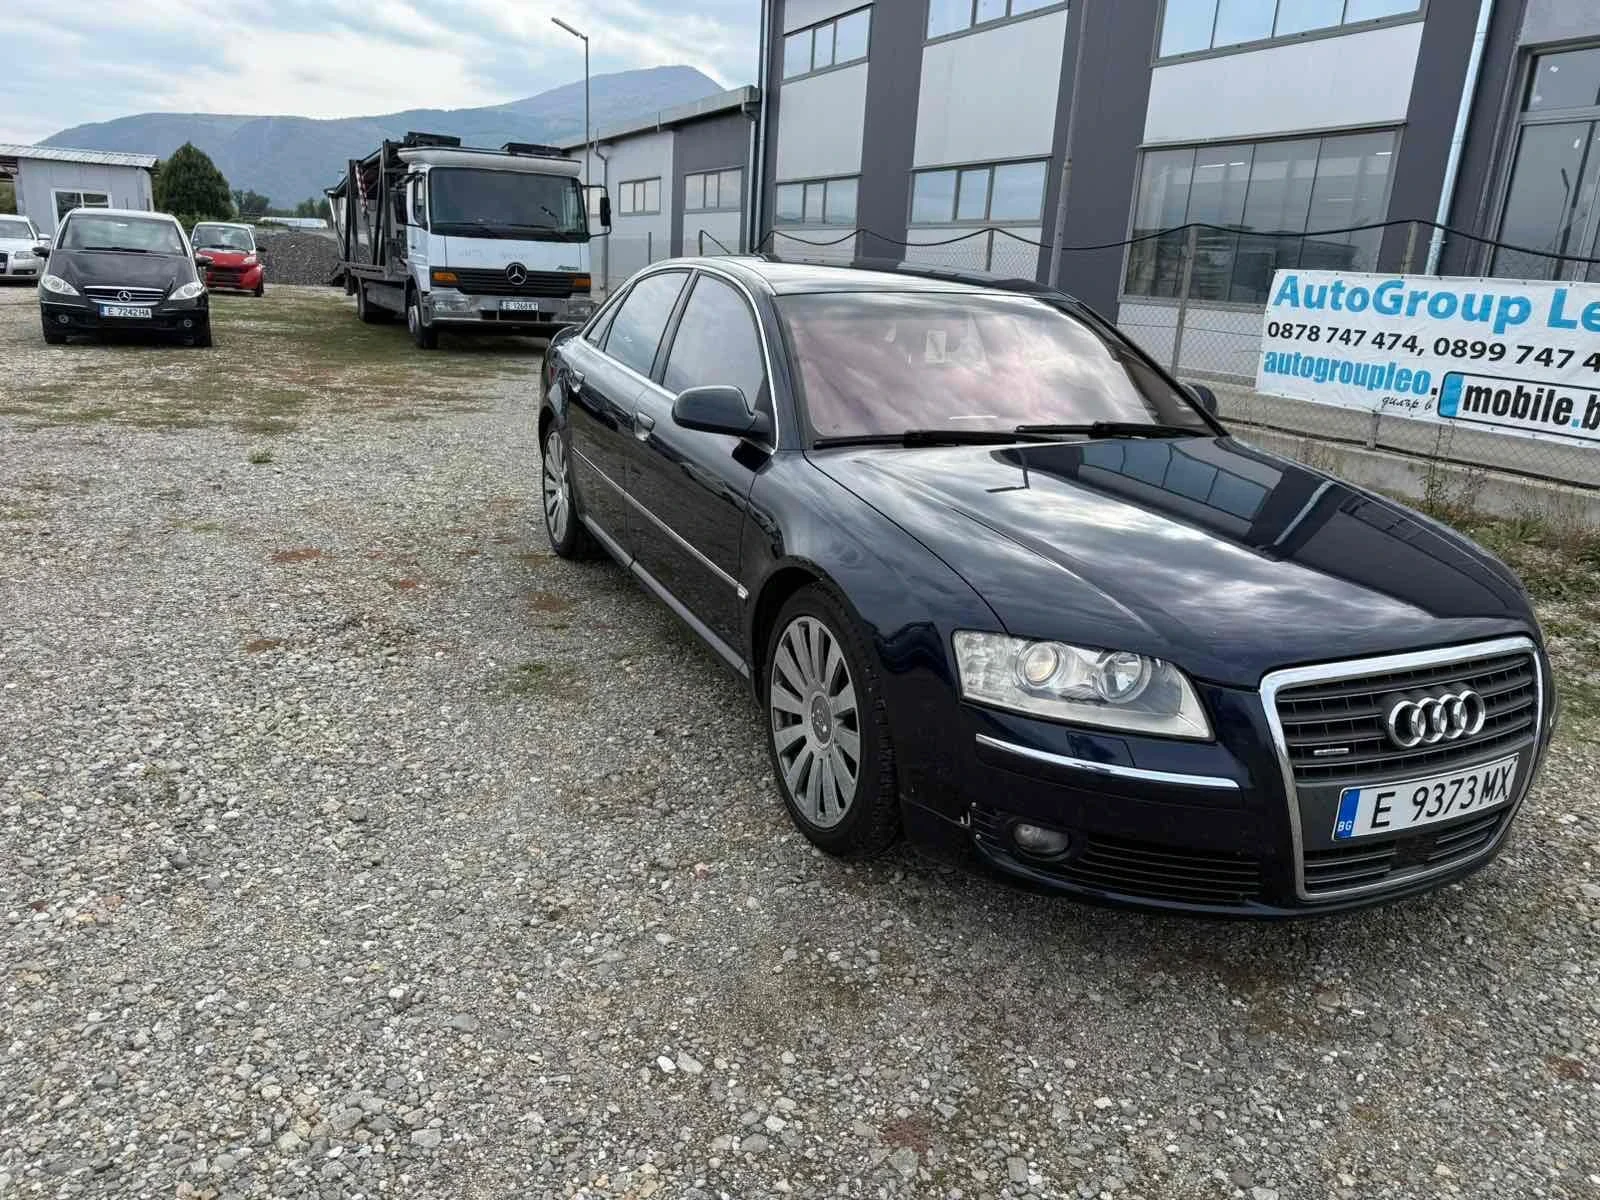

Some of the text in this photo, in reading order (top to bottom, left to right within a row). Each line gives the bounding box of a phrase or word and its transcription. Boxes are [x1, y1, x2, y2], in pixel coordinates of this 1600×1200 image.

[1272, 275, 1600, 334] AutoGroup Le
[1267, 321, 1321, 342] 0878
[1326, 326, 1366, 347] 747
[1371, 331, 1425, 356] 474,
[1433, 337, 1506, 362] 0899
[1515, 344, 1575, 368] 747
[1371, 763, 1513, 829] E 9373MX
[1337, 820, 1352, 832] BG
